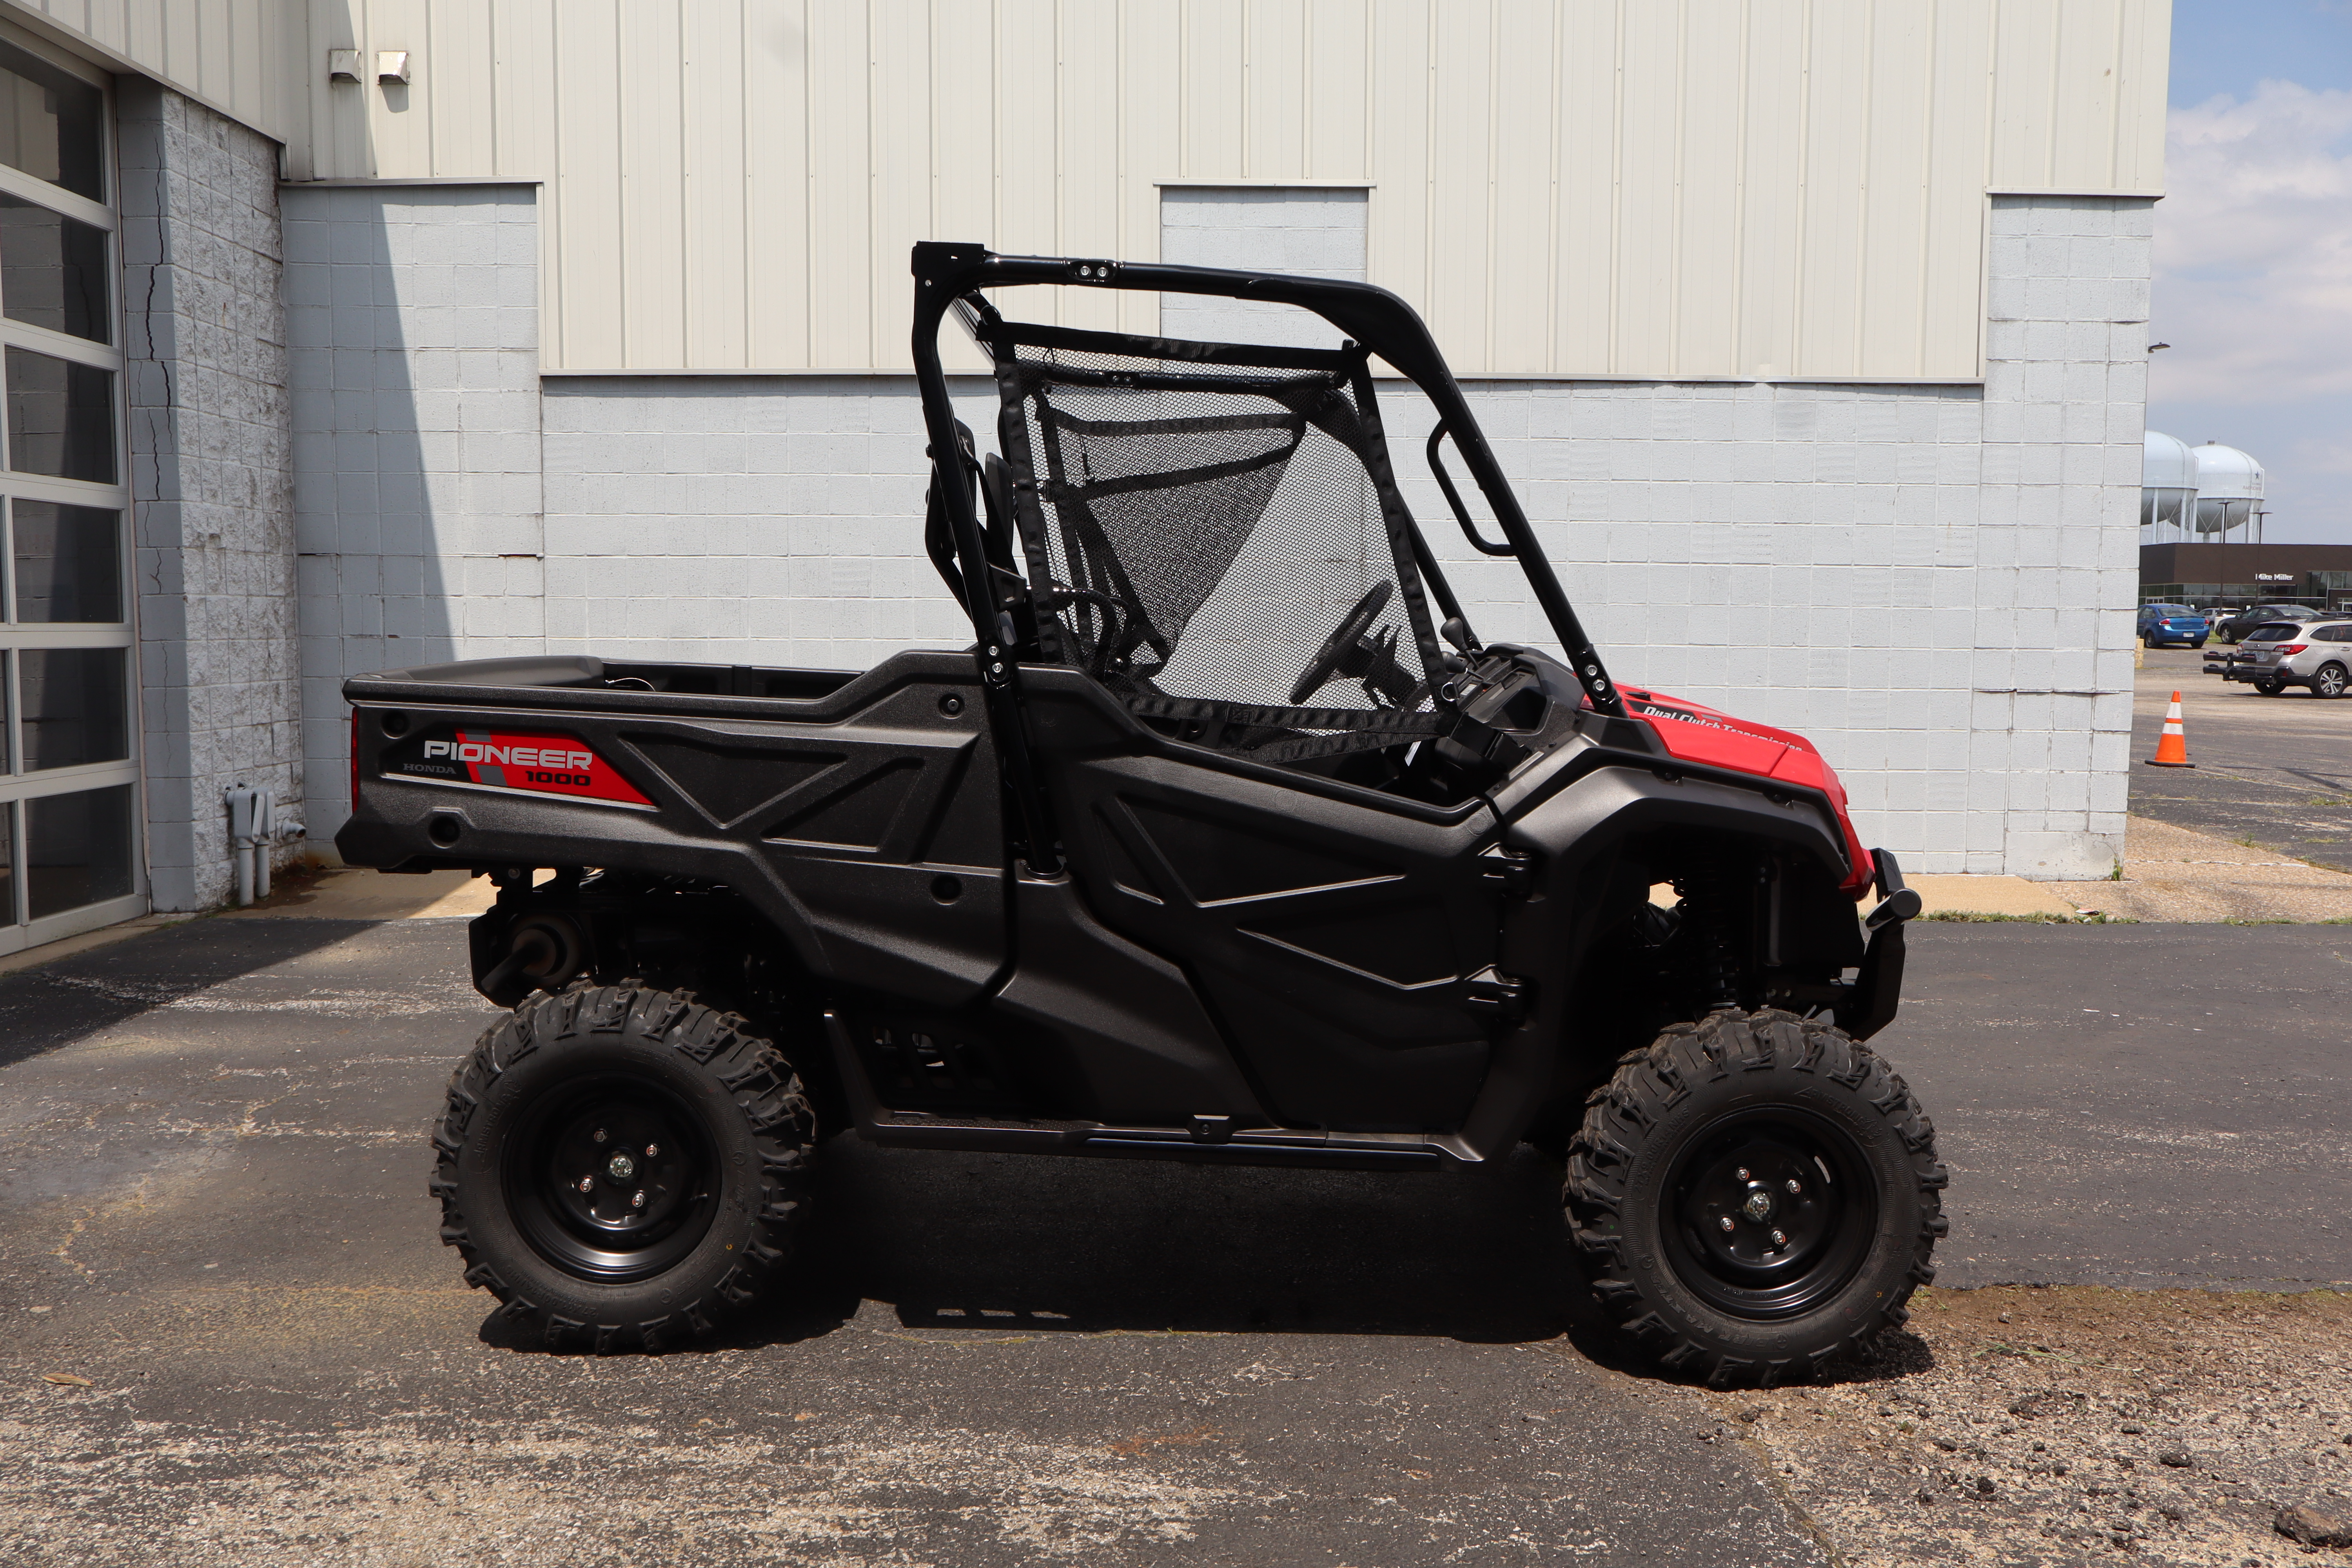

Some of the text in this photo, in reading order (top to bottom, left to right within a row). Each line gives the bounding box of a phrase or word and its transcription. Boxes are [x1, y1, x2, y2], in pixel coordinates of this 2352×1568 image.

[1643, 706, 1677, 720] Dual
[424, 740, 592, 770] PIONEER
[403, 763, 456, 774] HONDA
[525, 770, 590, 786] 1000
[1794, 1086, 1866, 1125] ARMSTRONG
[1647, 1272, 1715, 1335] MASTER
